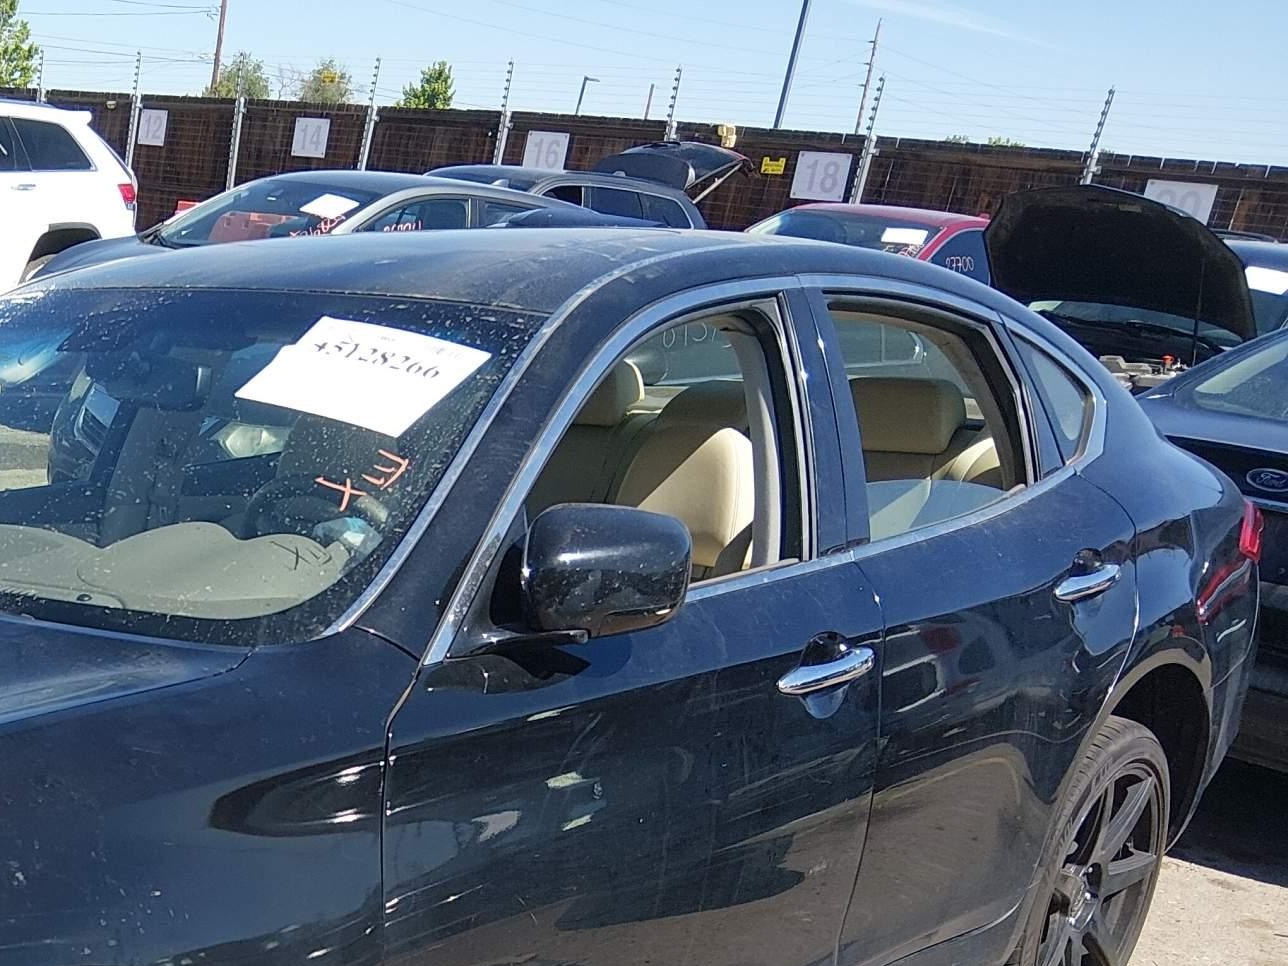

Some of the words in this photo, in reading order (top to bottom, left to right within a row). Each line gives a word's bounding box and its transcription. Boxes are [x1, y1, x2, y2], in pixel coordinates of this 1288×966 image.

[145, 114, 163, 140] 12
[300, 123, 323, 151] 14
[535, 138, 561, 169] 16
[806, 159, 841, 194] 18
